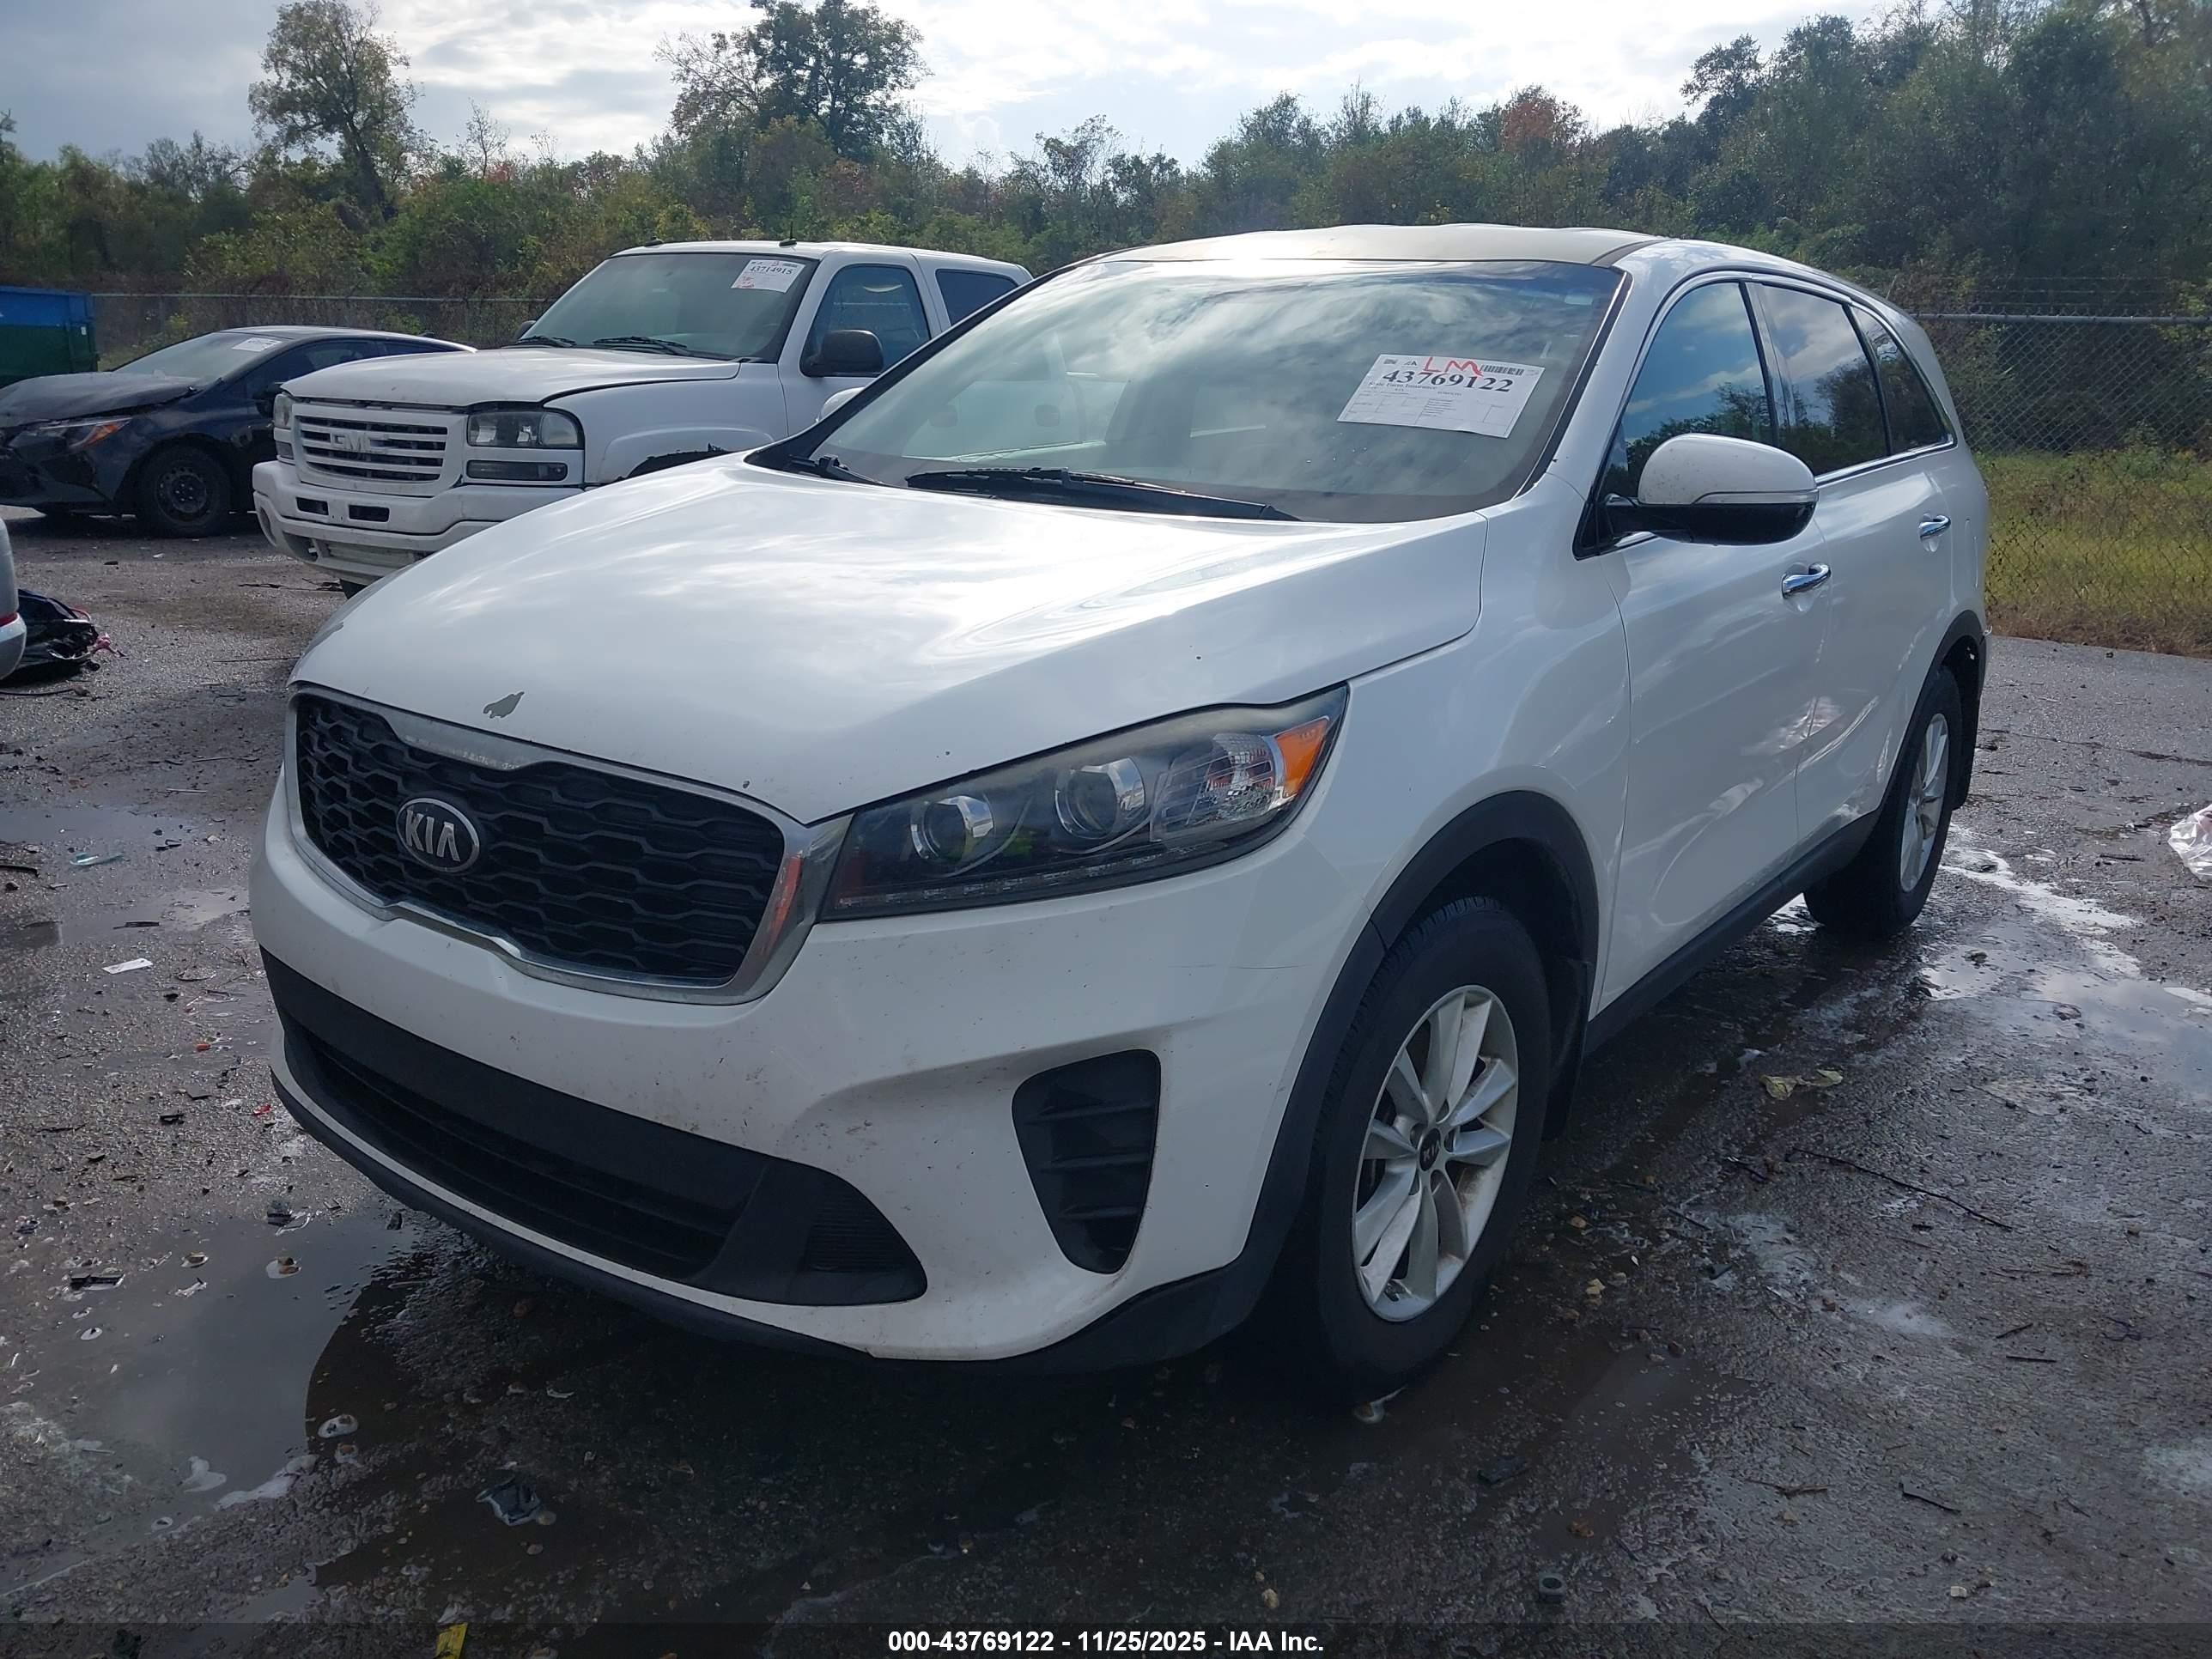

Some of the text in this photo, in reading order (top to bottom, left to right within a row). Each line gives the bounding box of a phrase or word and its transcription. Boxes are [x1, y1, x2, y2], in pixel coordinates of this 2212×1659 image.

[1382, 369, 1514, 392] 43769122
[330, 431, 389, 454] GMC
[405, 809, 461, 862] KIA
